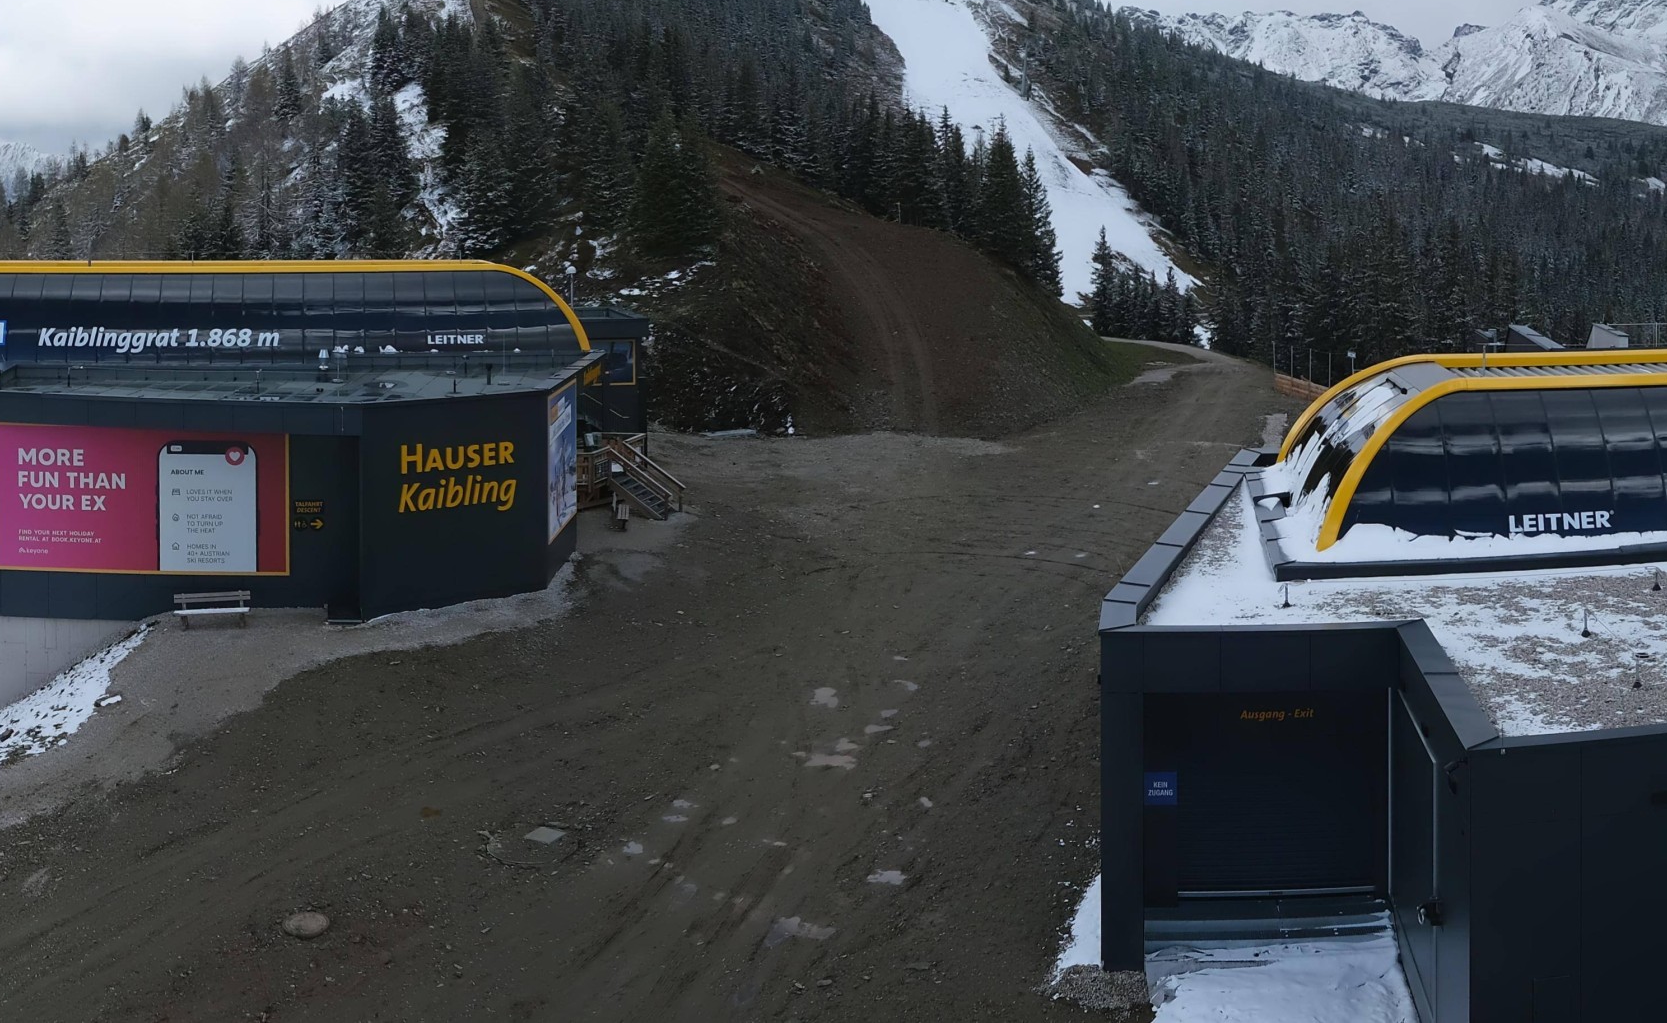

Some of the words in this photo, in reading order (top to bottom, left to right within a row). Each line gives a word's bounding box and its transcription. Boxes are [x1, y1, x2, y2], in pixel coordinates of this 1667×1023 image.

[38, 326, 180, 354] Kaiblinggrat
[185, 328, 252, 347] 1.868
[257, 331, 280, 347] m
[427, 334, 484, 345] LEITNER
[18, 447, 84, 466] MORE
[400, 441, 515, 475] HAUSER
[18, 471, 58, 488] FUN
[66, 472, 125, 490] THAN
[19, 493, 74, 510] YOUR
[81, 495, 106, 511] EX
[398, 474, 517, 513] Kaibling
[1508, 510, 1612, 533] LEITNER
[26, 547, 48, 555] keyone
[1240, 710, 1285, 721] Ausgang
[1294, 708, 1314, 718] Exit
